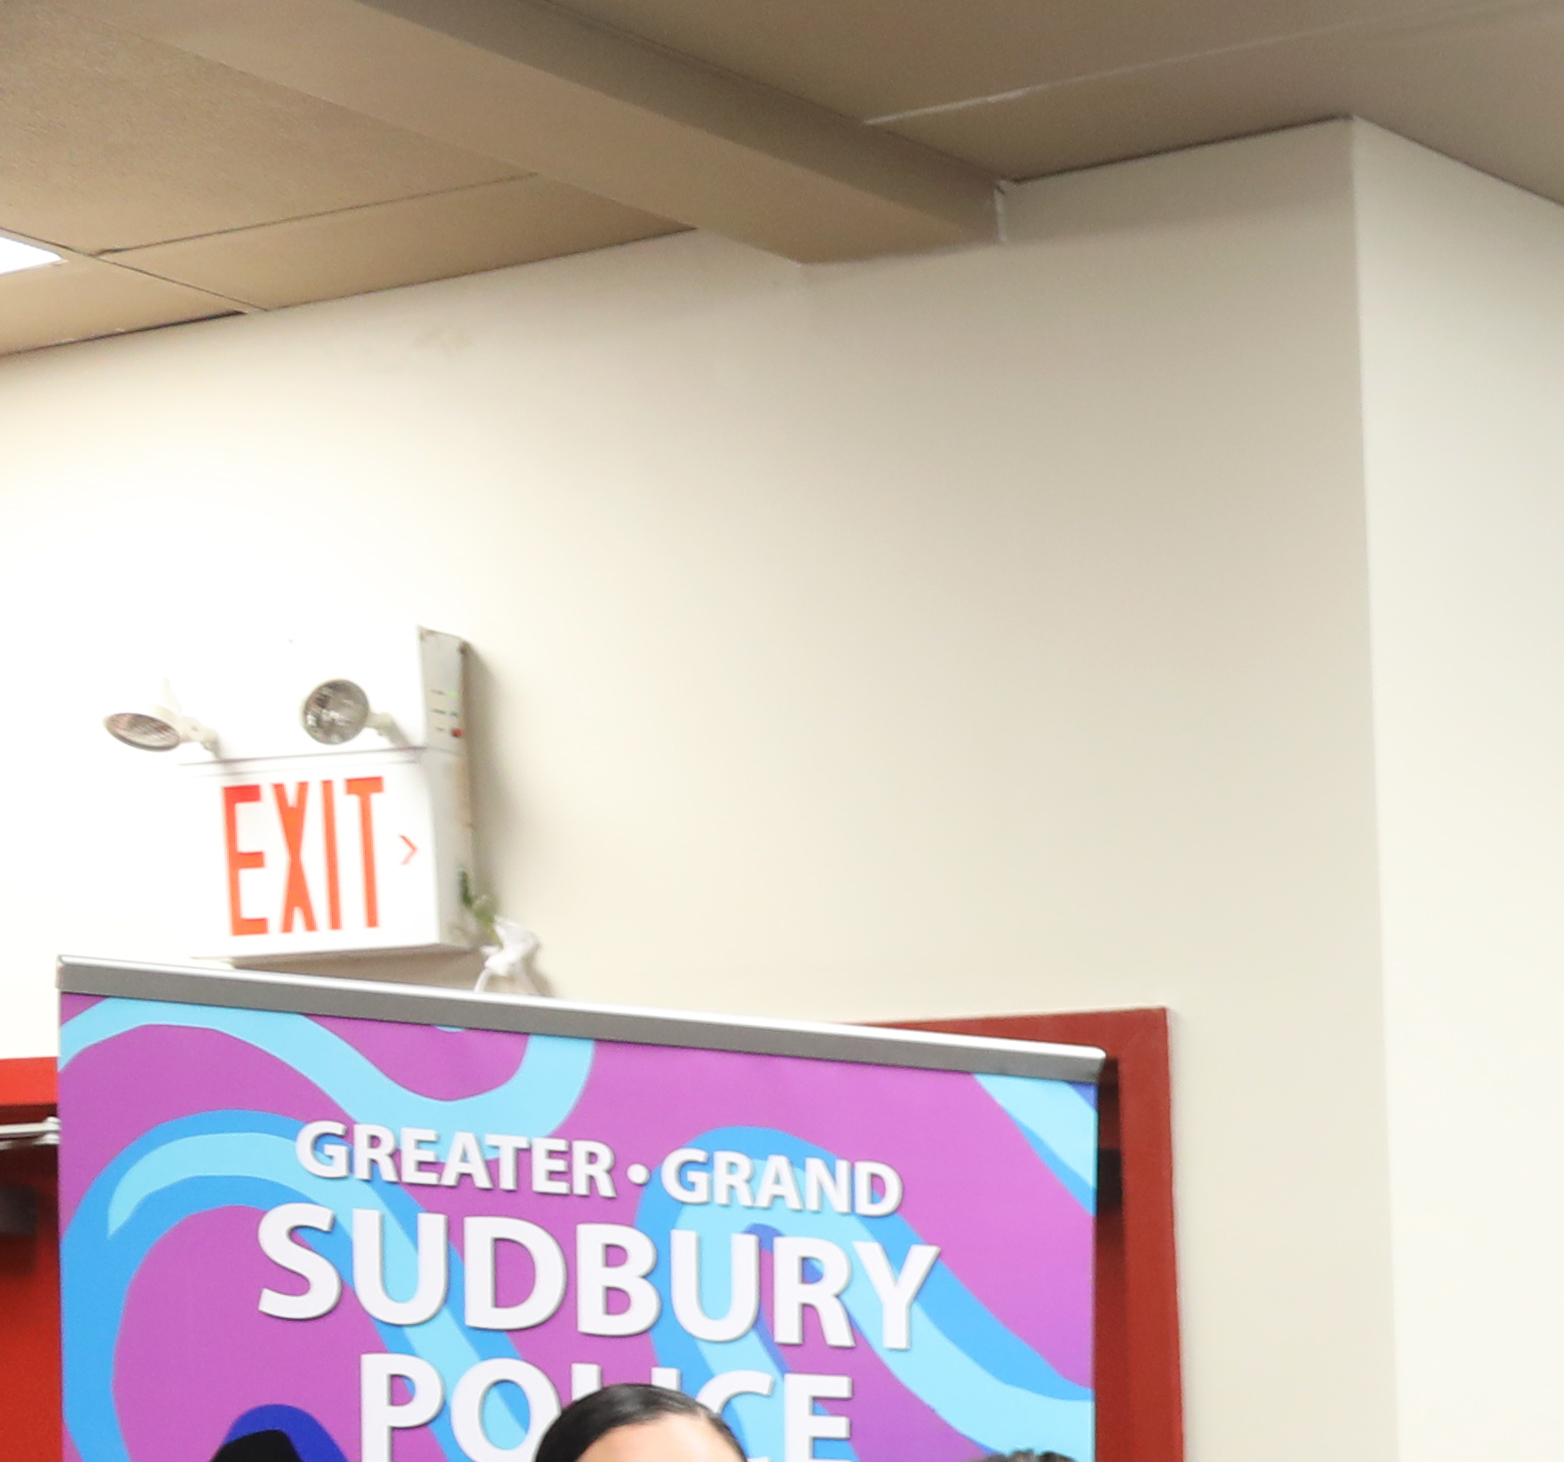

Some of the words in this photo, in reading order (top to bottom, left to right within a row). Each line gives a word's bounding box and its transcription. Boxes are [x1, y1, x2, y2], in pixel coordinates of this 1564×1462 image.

[223, 775, 384, 937] EXIT
[297, 1120, 616, 1198] GREATER
[661, 1147, 904, 1217] GRAND
[257, 1202, 942, 1350] SUDBURY
